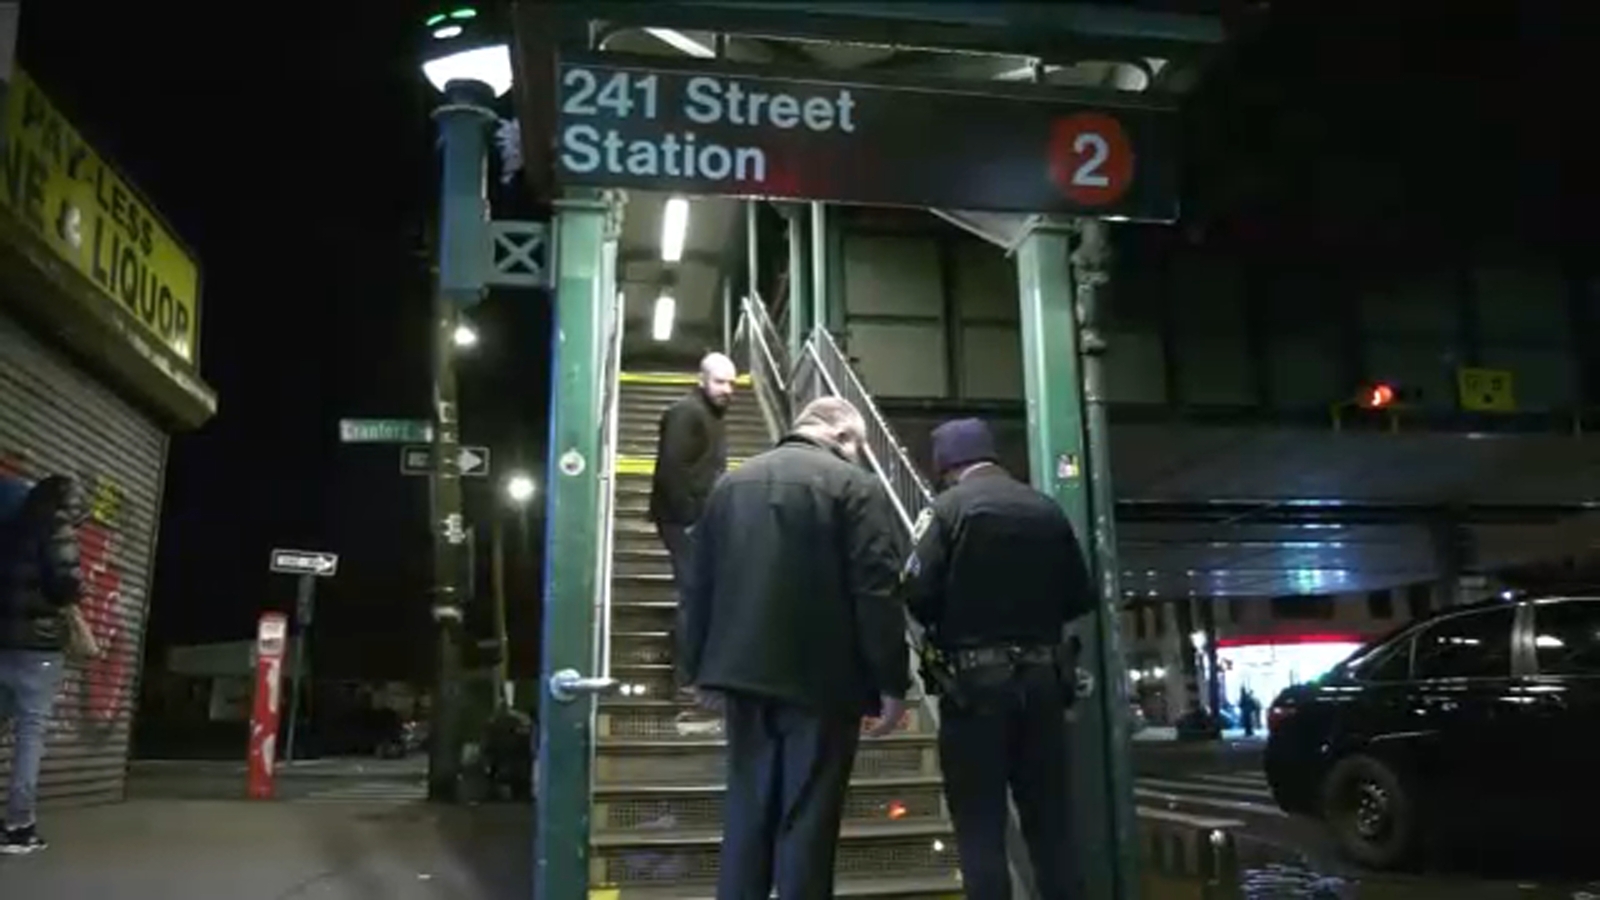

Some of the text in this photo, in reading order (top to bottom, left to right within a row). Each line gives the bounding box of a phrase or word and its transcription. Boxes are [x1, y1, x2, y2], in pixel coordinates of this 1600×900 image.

[562, 68, 856, 132] 241 Street
[561, 124, 767, 182] Station
[1071, 133, 1109, 187] 2
[91, 217, 191, 357] LIQUOR
